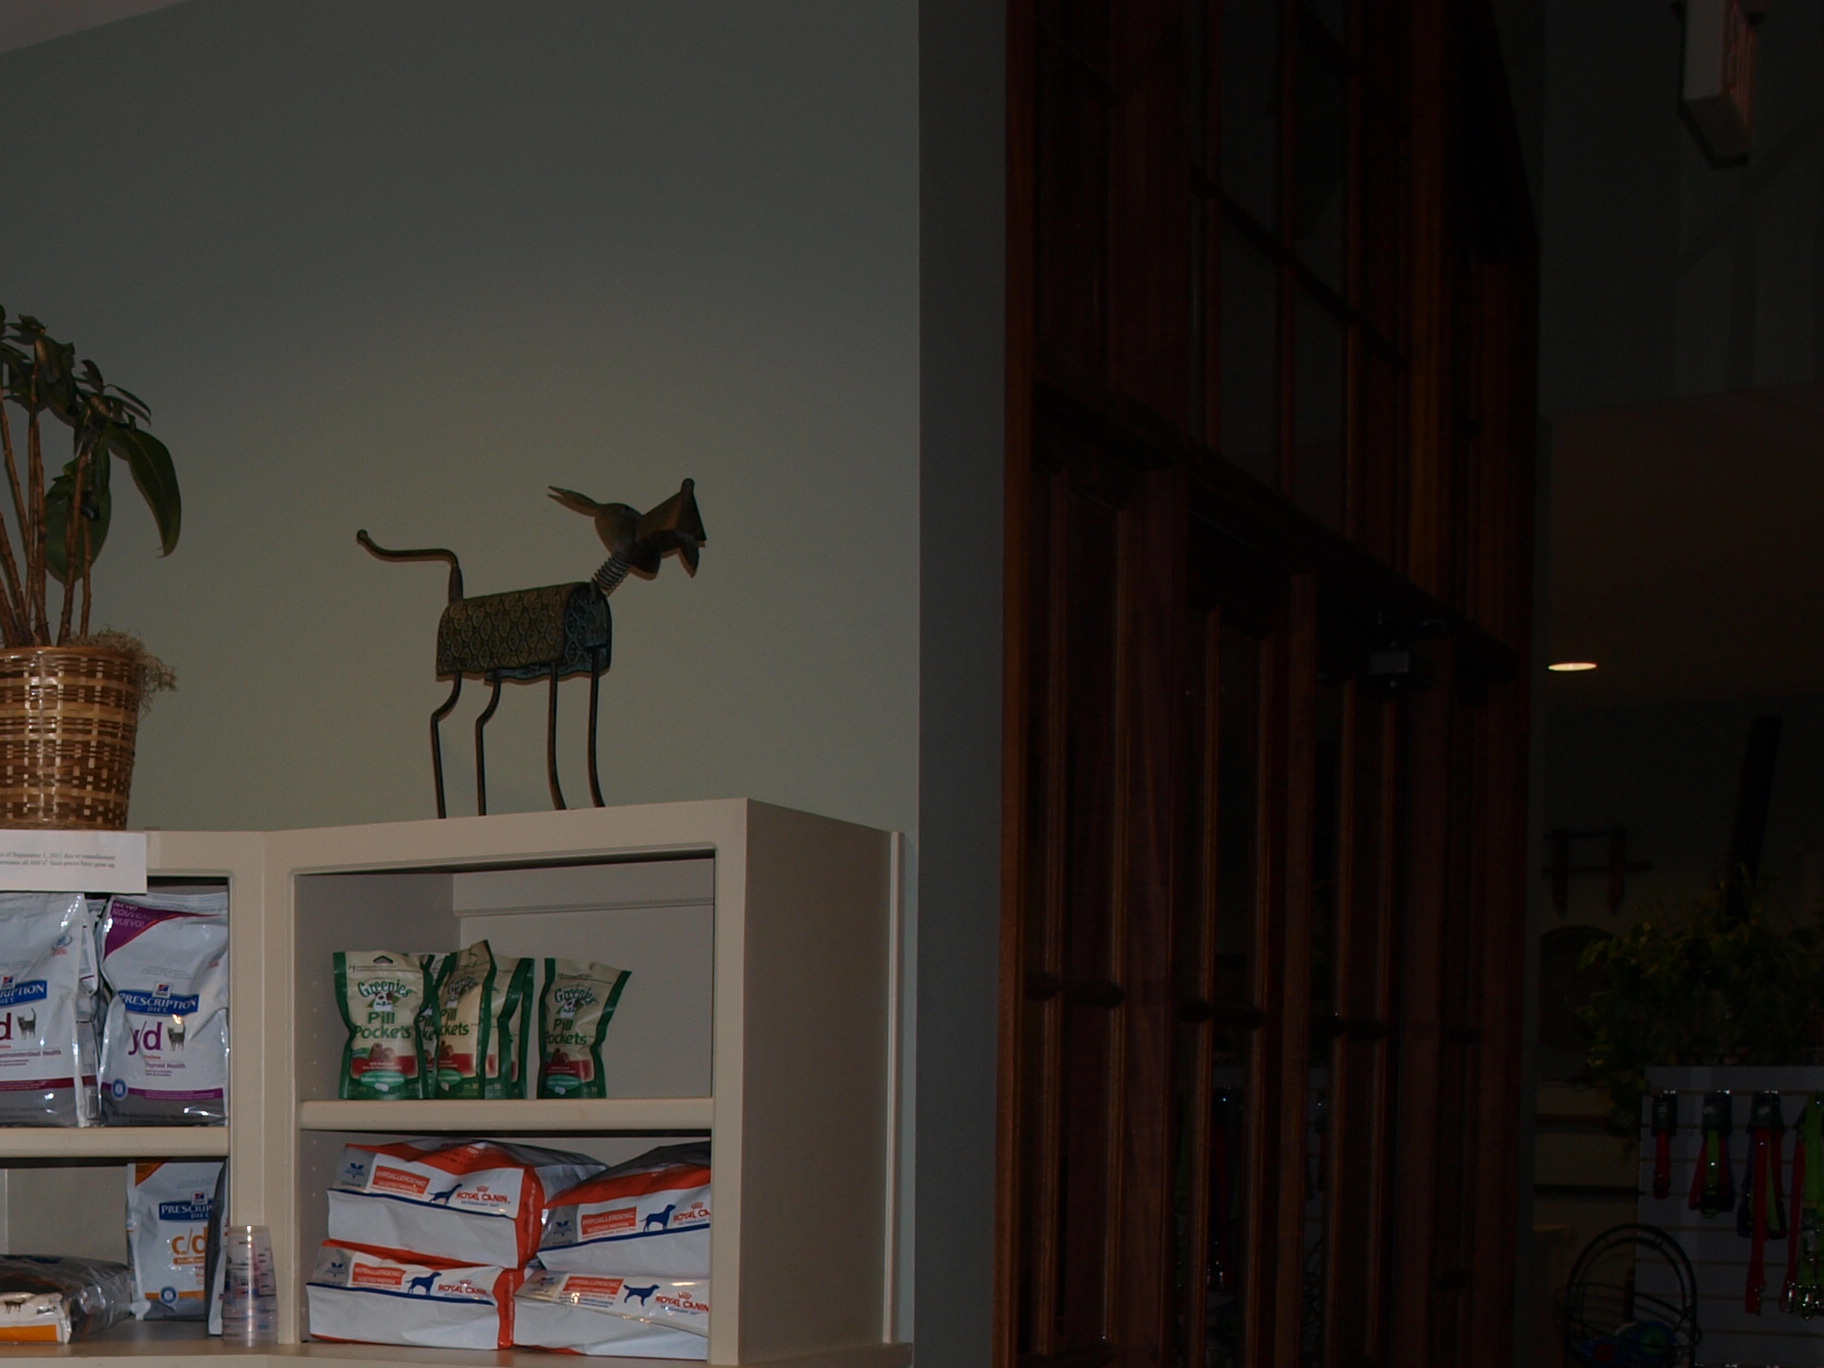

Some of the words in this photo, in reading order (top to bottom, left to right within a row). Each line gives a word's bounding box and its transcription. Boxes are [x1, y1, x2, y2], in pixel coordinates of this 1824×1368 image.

[356, 978, 412, 998] Greenies
[368, 1011, 396, 1024] Pill
[354, 1024, 412, 1039] Pockets
[552, 1018, 574, 1032] Pill
[128, 1020, 162, 1056] y/d
[456, 1190, 480, 1201] ROYAL
[481, 1191, 510, 1204] CANIN
[672, 1209, 696, 1222] ROYAL
[171, 1226, 209, 1256] c/d
[438, 1284, 458, 1294] ROYAL
[654, 1296, 683, 1308] ROYAL
